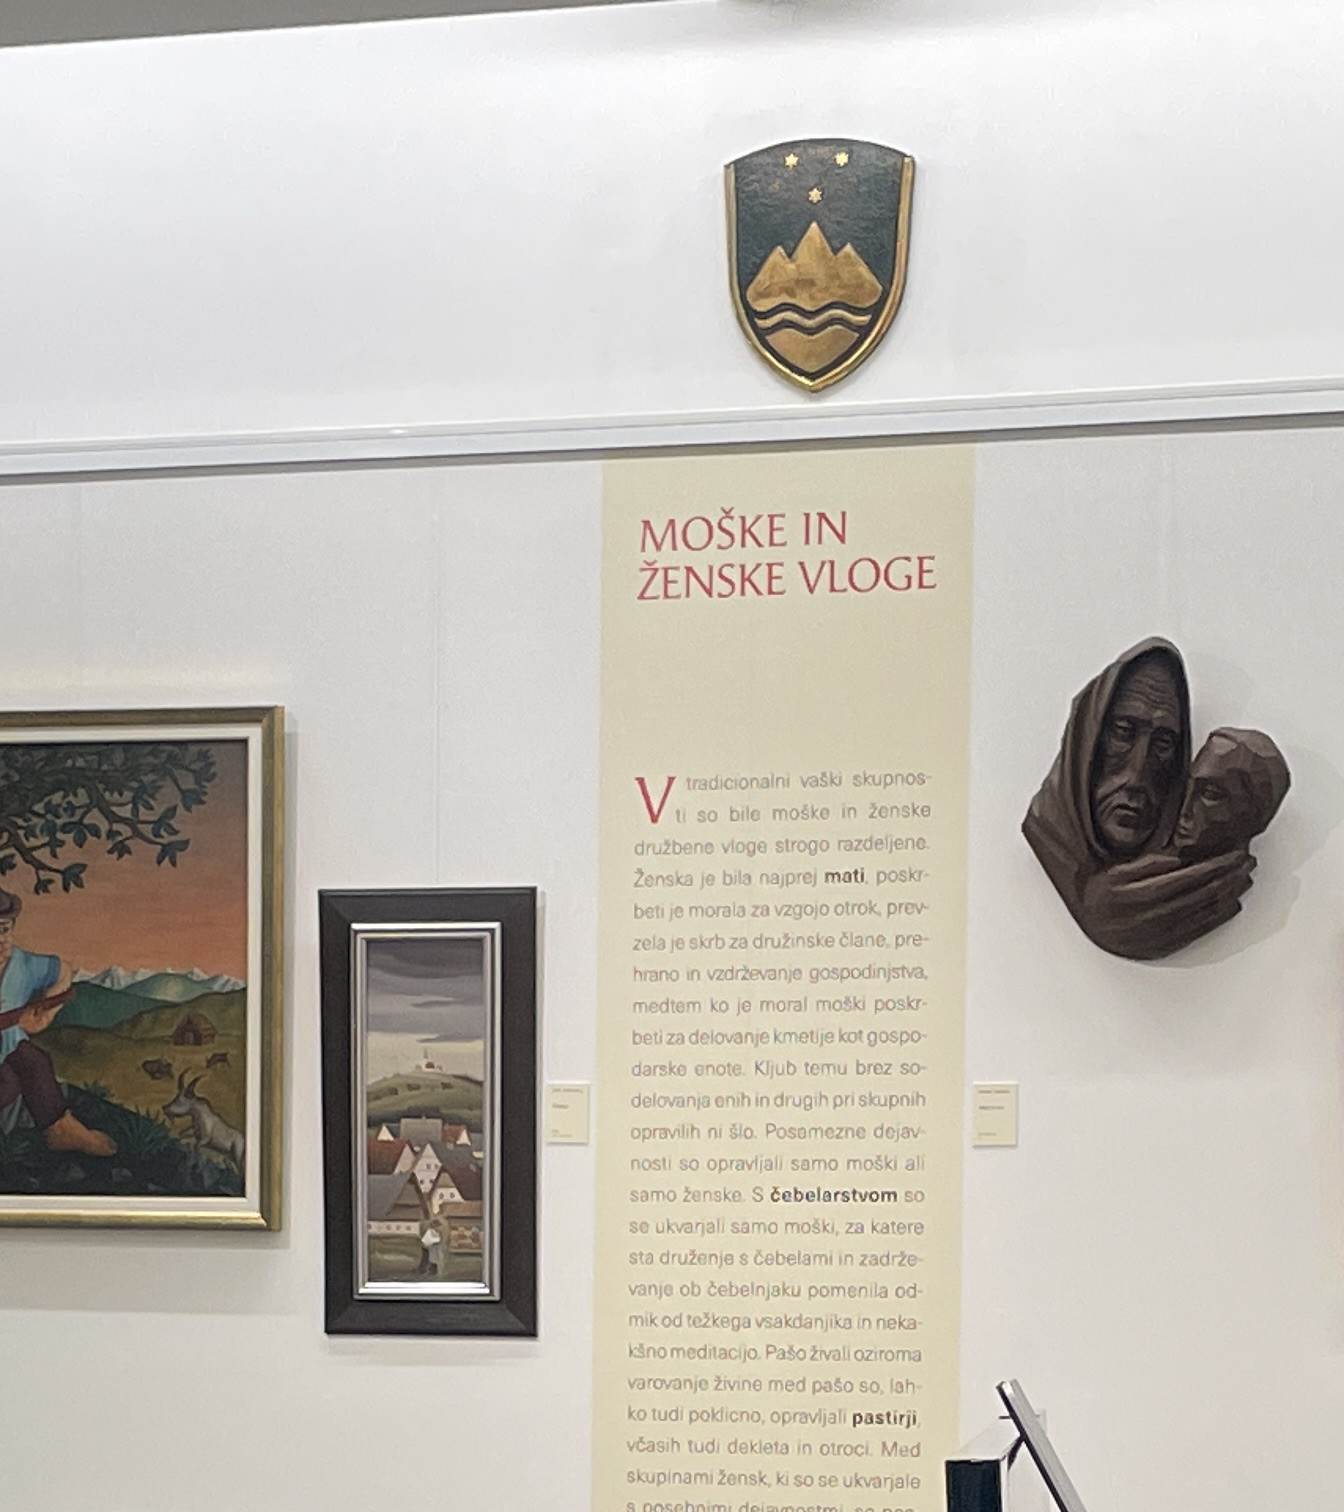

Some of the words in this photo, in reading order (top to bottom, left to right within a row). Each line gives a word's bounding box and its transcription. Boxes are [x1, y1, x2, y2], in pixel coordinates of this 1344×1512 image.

[640, 507, 788, 552] MOŠKE
[803, 511, 847, 545] IN
[637, 560, 786, 600] ŽENSKE
[798, 555, 937, 595] VLOGE
[635, 776, 676, 824] V
[686, 772, 790, 791] tradicionalni
[800, 772, 842, 788] vaški
[852, 771, 932, 790] skupnos-
[676, 807, 686, 823] ti
[697, 810, 718, 822] so
[730, 806, 761, 821] bile
[772, 805, 830, 820] moške
[842, 804, 857, 818] in
[868, 803, 931, 819] ženske
[634, 838, 714, 854] družbene
[721, 837, 767, 857] vloge
[775, 838, 830, 856] strogo
[634, 869, 693, 887] Ženska
[700, 870, 715, 890] je
[722, 868, 751, 885] bila
[759, 870, 818, 888] najprej
[876, 866, 929, 885] poskr-
[633, 903, 664, 919] beti
[668, 903, 684, 921] je
[689, 901, 746, 918] morala
[751, 904, 770, 917] za
[774, 901, 830, 920] vzgojo
[887, 902, 928, 918] prev-
[633, 933, 666, 951] zela
[670, 936, 685, 953] je
[689, 932, 725, 950] skrb
[729, 936, 748, 949] za
[753, 932, 834, 949] družinske
[895, 934, 929, 950] pre-
[633, 966, 680, 982] hrano
[686, 966, 700, 980] in
[707, 964, 802, 983] vzdrževanje
[633, 997, 701, 1014] medtem
[711, 997, 729, 1013] ko
[737, 997, 751, 1016] je
[760, 996, 807, 1012] moral
[816, 995, 865, 1012] moški
[874, 996, 927, 1014] poskr-
[632, 1029, 663, 1045] beti
[667, 1032, 685, 1045] za
[689, 1029, 770, 1048] delovanje
[774, 1028, 834, 1047] kmetije
[839, 1028, 863, 1043] kot
[867, 1030, 928, 1048] gospo-
[631, 1060, 687, 1077] darske
[754, 1060, 797, 1078] Kljub
[804, 1061, 847, 1075] temu
[856, 1059, 892, 1074] brez
[900, 1062, 927, 1074] so-
[631, 1092, 711, 1110] delovanja
[715, 1091, 751, 1107] enih
[755, 1092, 770, 1107] in
[774, 1091, 829, 1110] drugih
[832, 1091, 855, 1110] pri
[859, 1091, 926, 1109] skupnih
[631, 1123, 700, 1142] opravilih
[708, 1124, 722, 1139] ni
[765, 1123, 866, 1139] Posamezne
[631, 1155, 672, 1171] nosti
[680, 1158, 699, 1171] so
[707, 1154, 783, 1174] opravljali
[790, 1157, 838, 1171] samo
[846, 1154, 897, 1170] moški
[904, 1154, 925, 1170] ali
[630, 1190, 676, 1203] samo
[752, 1187, 764, 1202] S
[770, 1186, 898, 1203] čebelarstvom
[904, 1190, 925, 1203] so
[629, 1222, 649, 1234] se
[730, 1221, 778, 1234] samo
[785, 1218, 840, 1236] moški,
[845, 1221, 864, 1234] za
[871, 1218, 925, 1235] katere
[629, 1252, 654, 1266] sta
[659, 1249, 735, 1269] druženje
[739, 1253, 748, 1266] s
[753, 1249, 833, 1266] čebelami
[838, 1250, 854, 1266] in
[859, 1250, 924, 1267] zadrže-
[628, 1282, 674, 1300] vanje
[680, 1281, 700, 1297] ob
[707, 1280, 801, 1300] čebelnjaku
[808, 1282, 888, 1301] pomenila
[895, 1283, 923, 1298] od-
[628, 1312, 659, 1328] mik
[662, 1312, 682, 1328] od
[687, 1313, 751, 1332] težkega
[755, 1313, 852, 1332] vsakdanjika
[857, 1314, 872, 1329] in
[876, 1314, 923, 1330] neka-
[628, 1343, 667, 1359] kšno
[766, 1344, 806, 1361] Pašo
[810, 1345, 850, 1361] živali
[854, 1347, 922, 1362] oziroma
[628, 1377, 708, 1394] varovanje
[714, 1375, 762, 1392] živine
[768, 1377, 806, 1392] med
[812, 1377, 854, 1396] pašo
[859, 1380, 884, 1395] so,
[890, 1378, 923, 1395] lah-
[628, 1407, 647, 1421] ko
[652, 1407, 683, 1422] tudi
[689, 1408, 765, 1426] poklicno,
[770, 1409, 847, 1428] opravljali
[627, 1437, 680, 1452] včasih
[688, 1438, 719, 1453] tudi
[728, 1438, 789, 1455] dekleta
[798, 1440, 812, 1455] in
[880, 1441, 920, 1458] Med
[627, 1468, 714, 1486] skupinami
[718, 1469, 771, 1487] žensk,
[776, 1470, 789, 1486] ki
[794, 1474, 814, 1487] so
[818, 1474, 838, 1487] se
